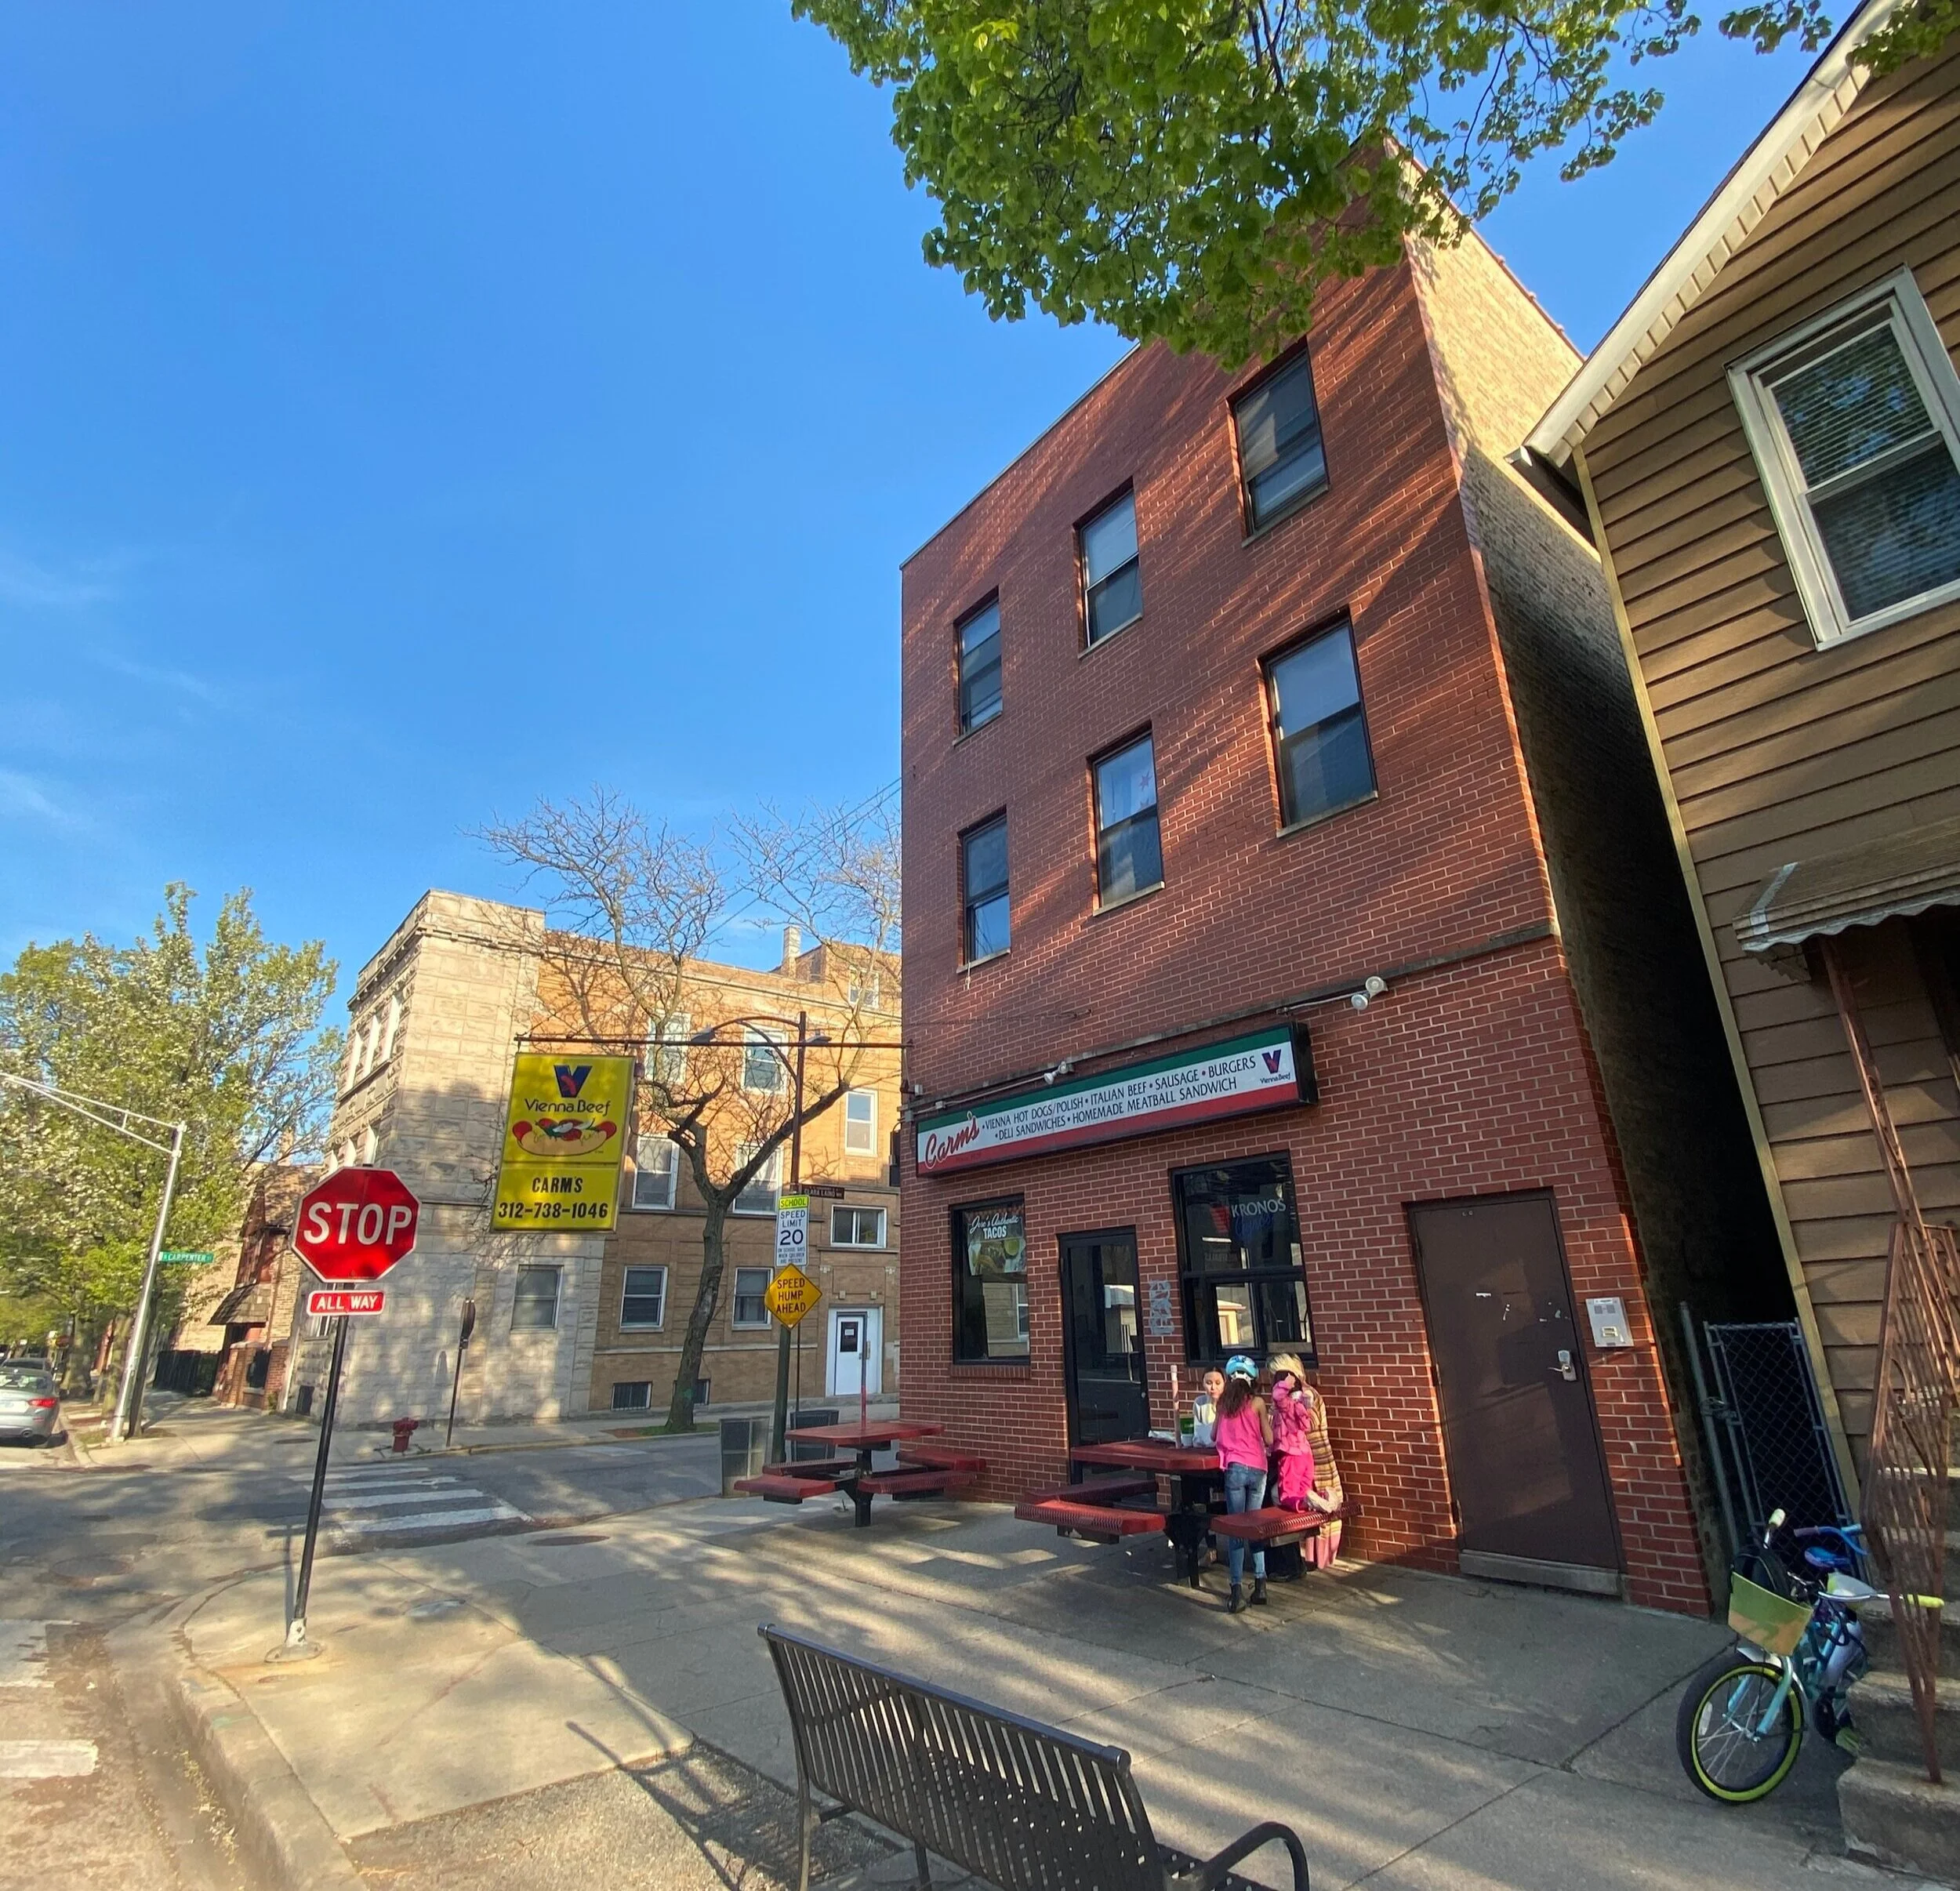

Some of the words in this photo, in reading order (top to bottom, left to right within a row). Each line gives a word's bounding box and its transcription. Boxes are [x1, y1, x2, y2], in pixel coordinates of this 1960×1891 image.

[1260, 1076, 1278, 1085] Vienna
[1278, 1072, 1291, 1081] Beef
[986, 1115, 1011, 1130] VIENNA
[1014, 1110, 1029, 1123] HOT
[1031, 1096, 1083, 1118] DOGS/POLISH
[1091, 1085, 1125, 1105] ITALIAN
[1127, 1082, 1147, 1098] BEEF
[1155, 1069, 1199, 1091] SAUSAGE
[1209, 1055, 1256, 1078] BURGERS
[525, 1098, 574, 1113] Vienna
[577, 1100, 611, 1117] Beef
[999, 1127, 1014, 1141] DELI
[1016, 1116, 1066, 1136] SANDWICHES
[1072, 1101, 1124, 1124] HOMEMADE
[1127, 1088, 1176, 1112] MEATBALL
[1180, 1077, 1237, 1100] SANDWICH
[925, 1111, 980, 1169] Carm's
[532, 1176, 583, 1193] CARM'S
[498, 1202, 608, 1219] 312-738-1046
[780, 1199, 806, 1208] SCHOOL
[1231, 1198, 1286, 1218] KRONOS
[780, 1210, 805, 1219] SPEED
[303, 1201, 412, 1245] STOP
[782, 1219, 802, 1227] LIMIT
[780, 1229, 803, 1245] 20
[983, 1226, 1007, 1239] TACOS
[777, 1278, 805, 1289] SPEED
[316, 1296, 344, 1310] ALL
[350, 1295, 379, 1309] WAY
[778, 1290, 803, 1302] HUMP
[776, 1302, 806, 1314] AHEAD
